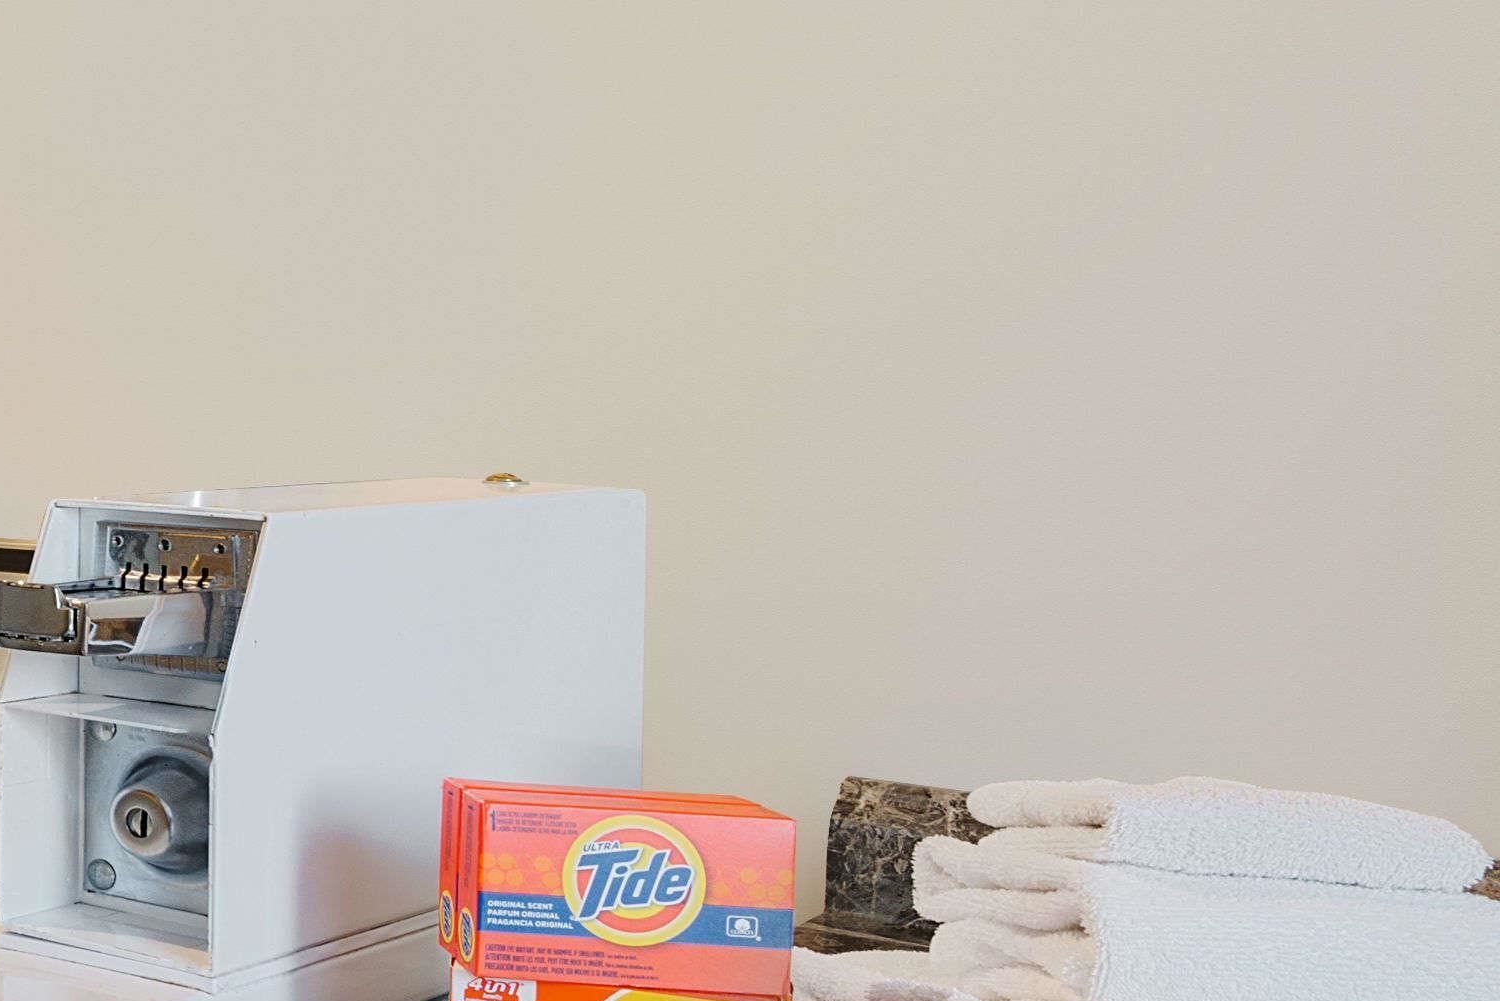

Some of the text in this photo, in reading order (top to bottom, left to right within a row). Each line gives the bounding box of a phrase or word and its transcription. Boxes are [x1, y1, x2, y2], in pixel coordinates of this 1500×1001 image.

[583, 841, 619, 853] ULTRA
[576, 848, 693, 920] Tide
[487, 900, 553, 910] ORIGINAL SCENT
[487, 909, 560, 920] PARFUM ORIGINAL
[487, 918, 574, 930] FRAGANCIA ORIGINAL
